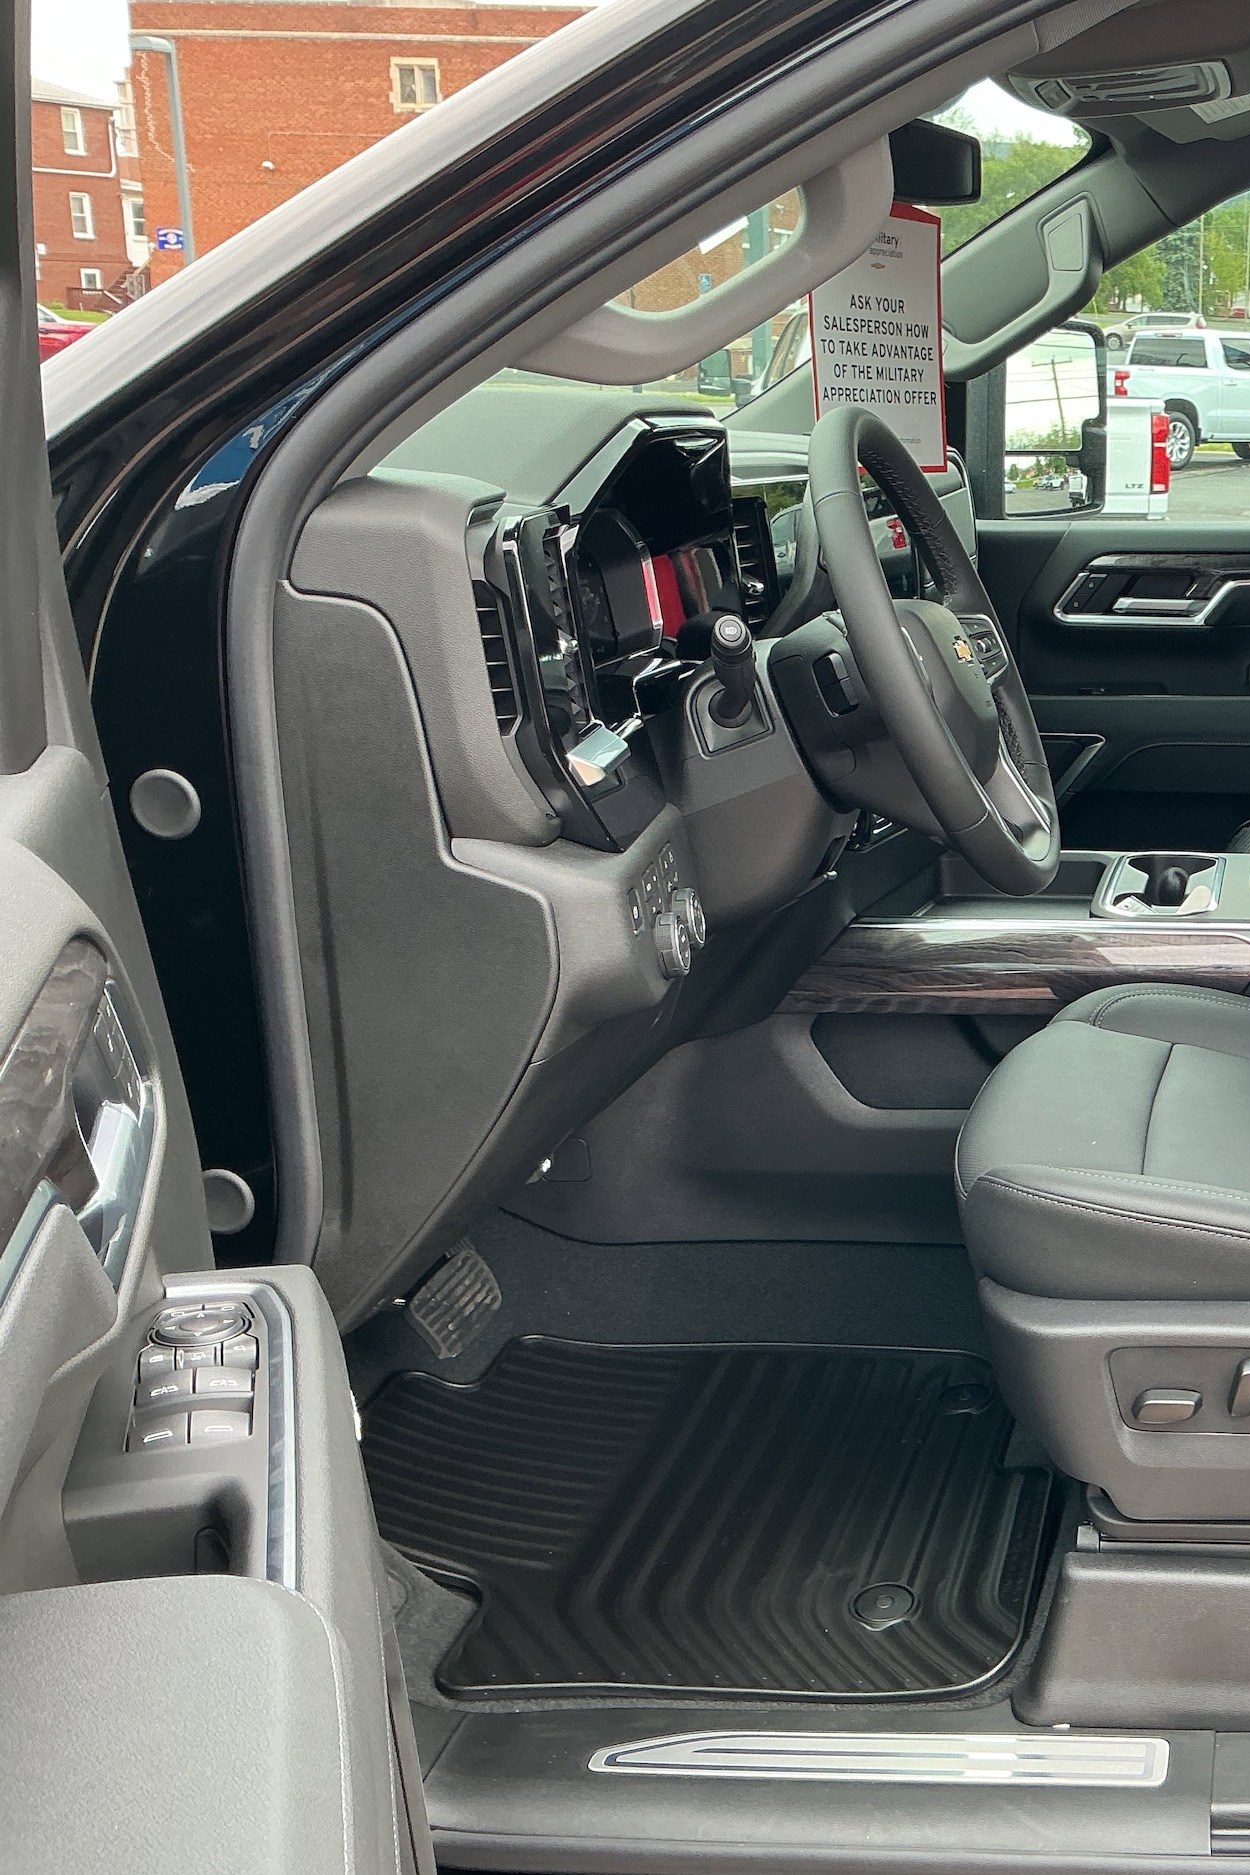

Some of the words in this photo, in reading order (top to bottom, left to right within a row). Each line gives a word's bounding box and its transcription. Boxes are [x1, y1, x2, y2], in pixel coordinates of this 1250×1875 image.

[849, 294, 872, 311] ASK
[875, 296, 905, 314] YOUR
[823, 314, 903, 337] SALESPERSON
[905, 323, 929, 339] HOW
[820, 338, 836, 355] TO
[838, 340, 868, 357] TAKE
[871, 342, 934, 361] ADVANTAGE
[833, 363, 848, 379] OF
[851, 364, 873, 380] THE
[876, 366, 924, 383] MILITARY
[822, 386, 901, 404] APPRECIATION
[903, 390, 937, 405] OFFER
